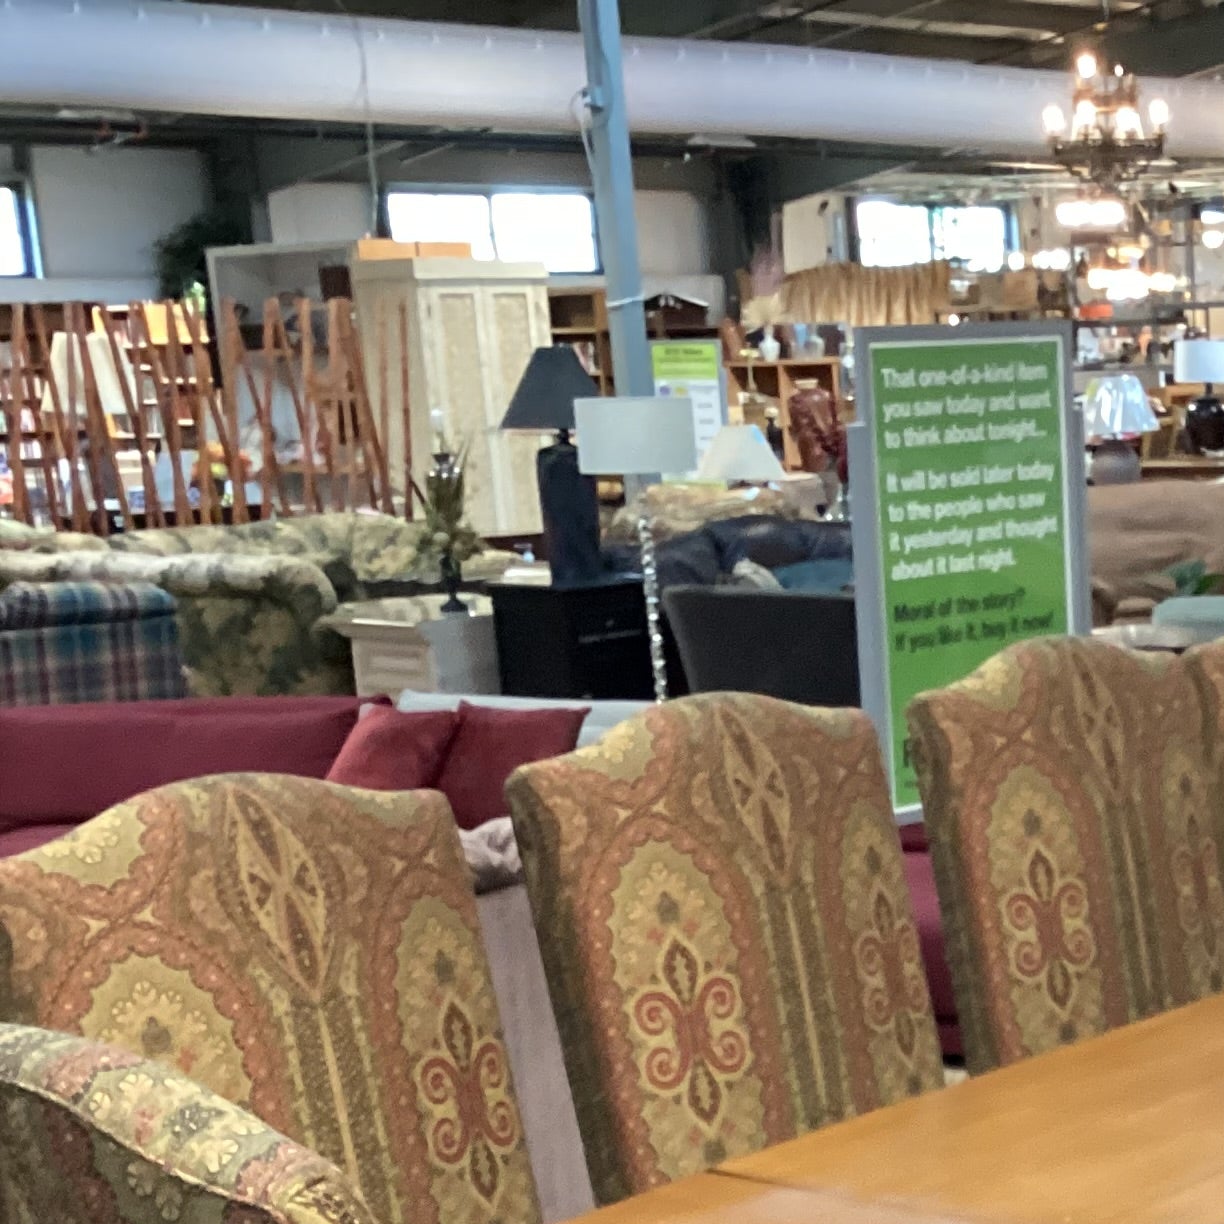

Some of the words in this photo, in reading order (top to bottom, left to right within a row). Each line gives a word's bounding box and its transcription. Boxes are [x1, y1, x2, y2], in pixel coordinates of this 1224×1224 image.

[881, 368, 915, 388] That
[946, 393, 985, 417] today
[884, 431, 900, 449] to
[944, 424, 985, 444] about
[928, 470, 947, 490] be
[1018, 461, 1054, 482] today
[888, 503, 904, 522] to
[907, 501, 931, 520] the
[934, 495, 983, 522] people
[986, 492, 1016, 511] who
[903, 526, 973, 555] yesterday
[976, 521, 1002, 541] and
[1005, 515, 1057, 539] thought
[891, 560, 933, 581] about
